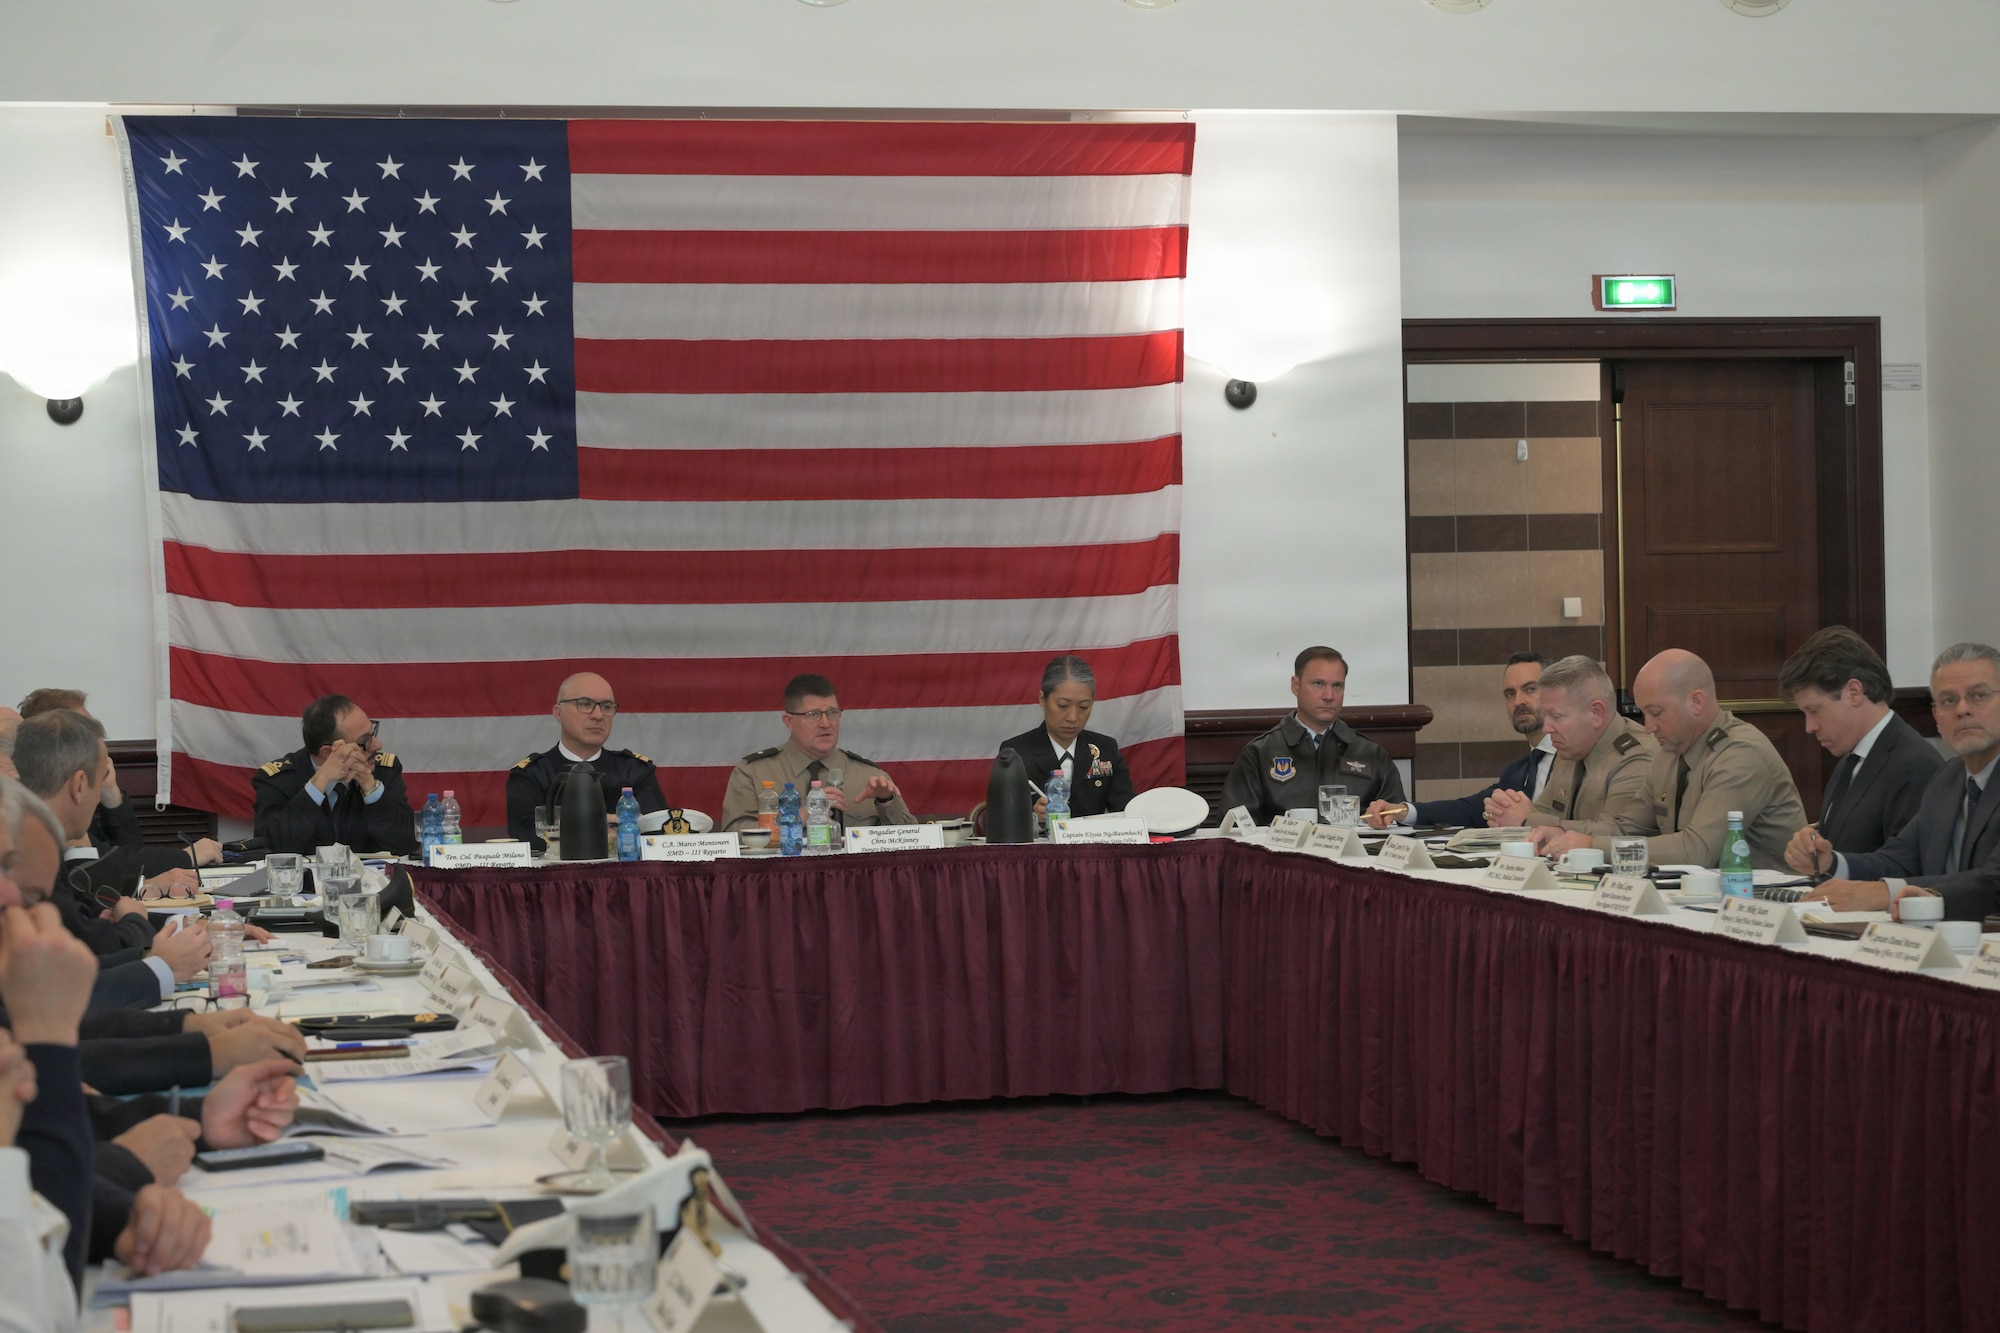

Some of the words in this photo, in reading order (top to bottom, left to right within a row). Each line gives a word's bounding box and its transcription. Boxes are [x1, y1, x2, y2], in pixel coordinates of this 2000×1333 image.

[897, 827, 920, 835] General
[702, 848, 727, 856] Reparto
[474, 852, 501, 861] Pasquale
